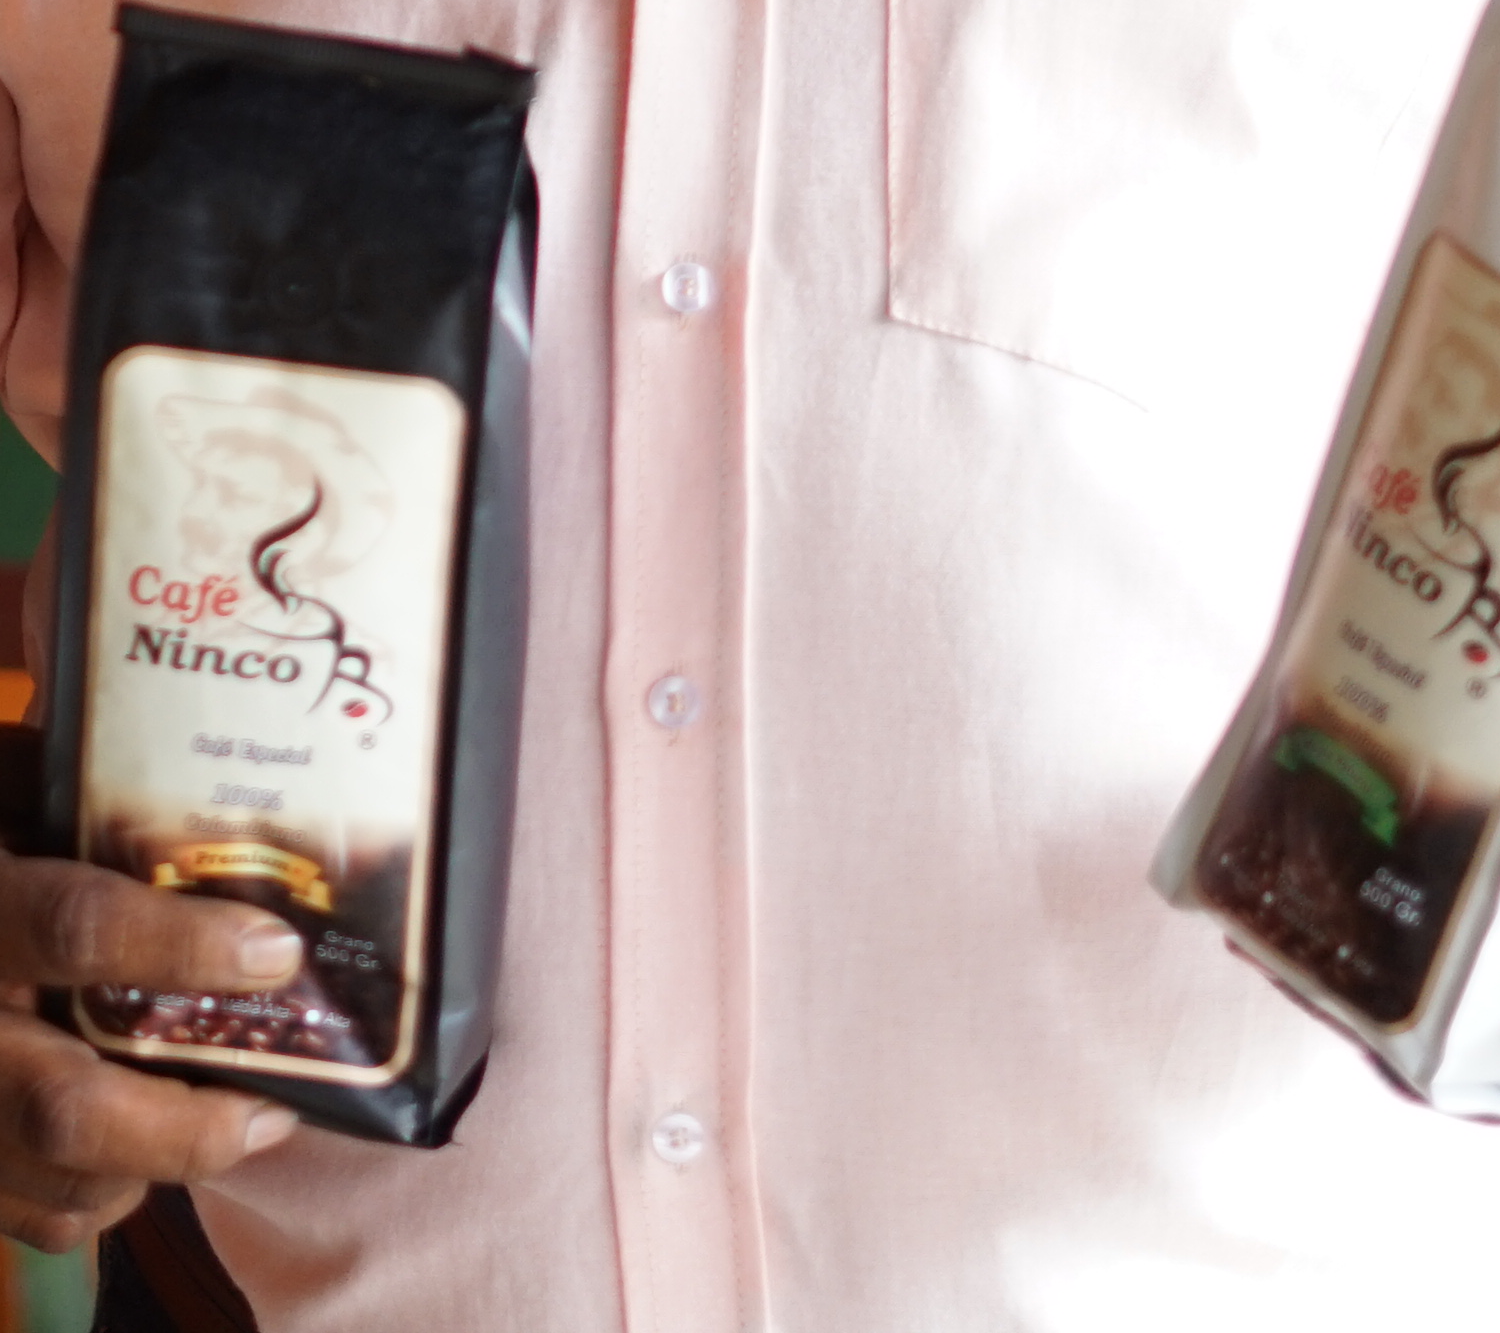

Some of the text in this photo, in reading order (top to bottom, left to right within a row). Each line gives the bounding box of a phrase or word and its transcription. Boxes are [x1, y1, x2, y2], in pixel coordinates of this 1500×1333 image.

[127, 565, 242, 625] Café
[125, 624, 301, 684] Ninco
[211, 783, 285, 811] 100%
[1360, 880, 1392, 909] 500
[1375, 866, 1423, 902] Grano
[315, 944, 351, 963] 500
[324, 930, 376, 952] Grano
